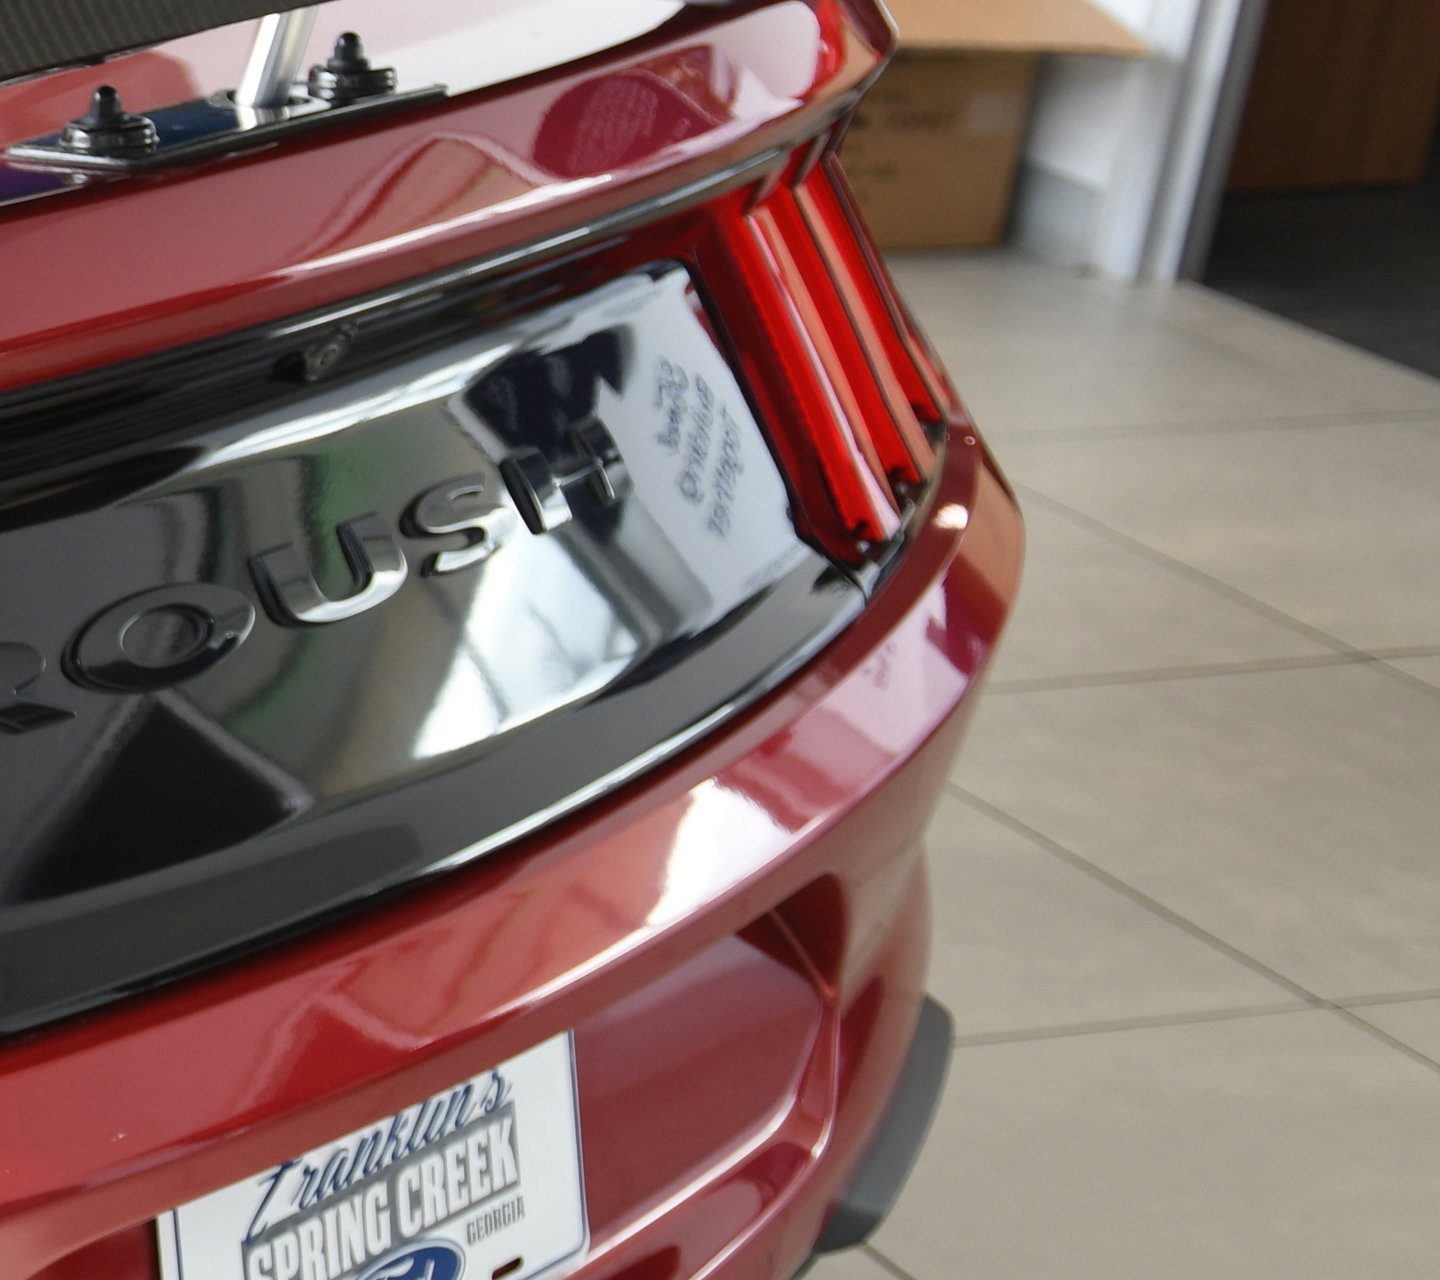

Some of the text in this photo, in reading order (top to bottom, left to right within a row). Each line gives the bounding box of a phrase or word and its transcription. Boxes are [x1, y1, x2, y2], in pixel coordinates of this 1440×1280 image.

[245, 1069, 512, 1242] Franklins
[398, 1113, 519, 1240] CREEK
[466, 1195, 525, 1247] GEORGIA
